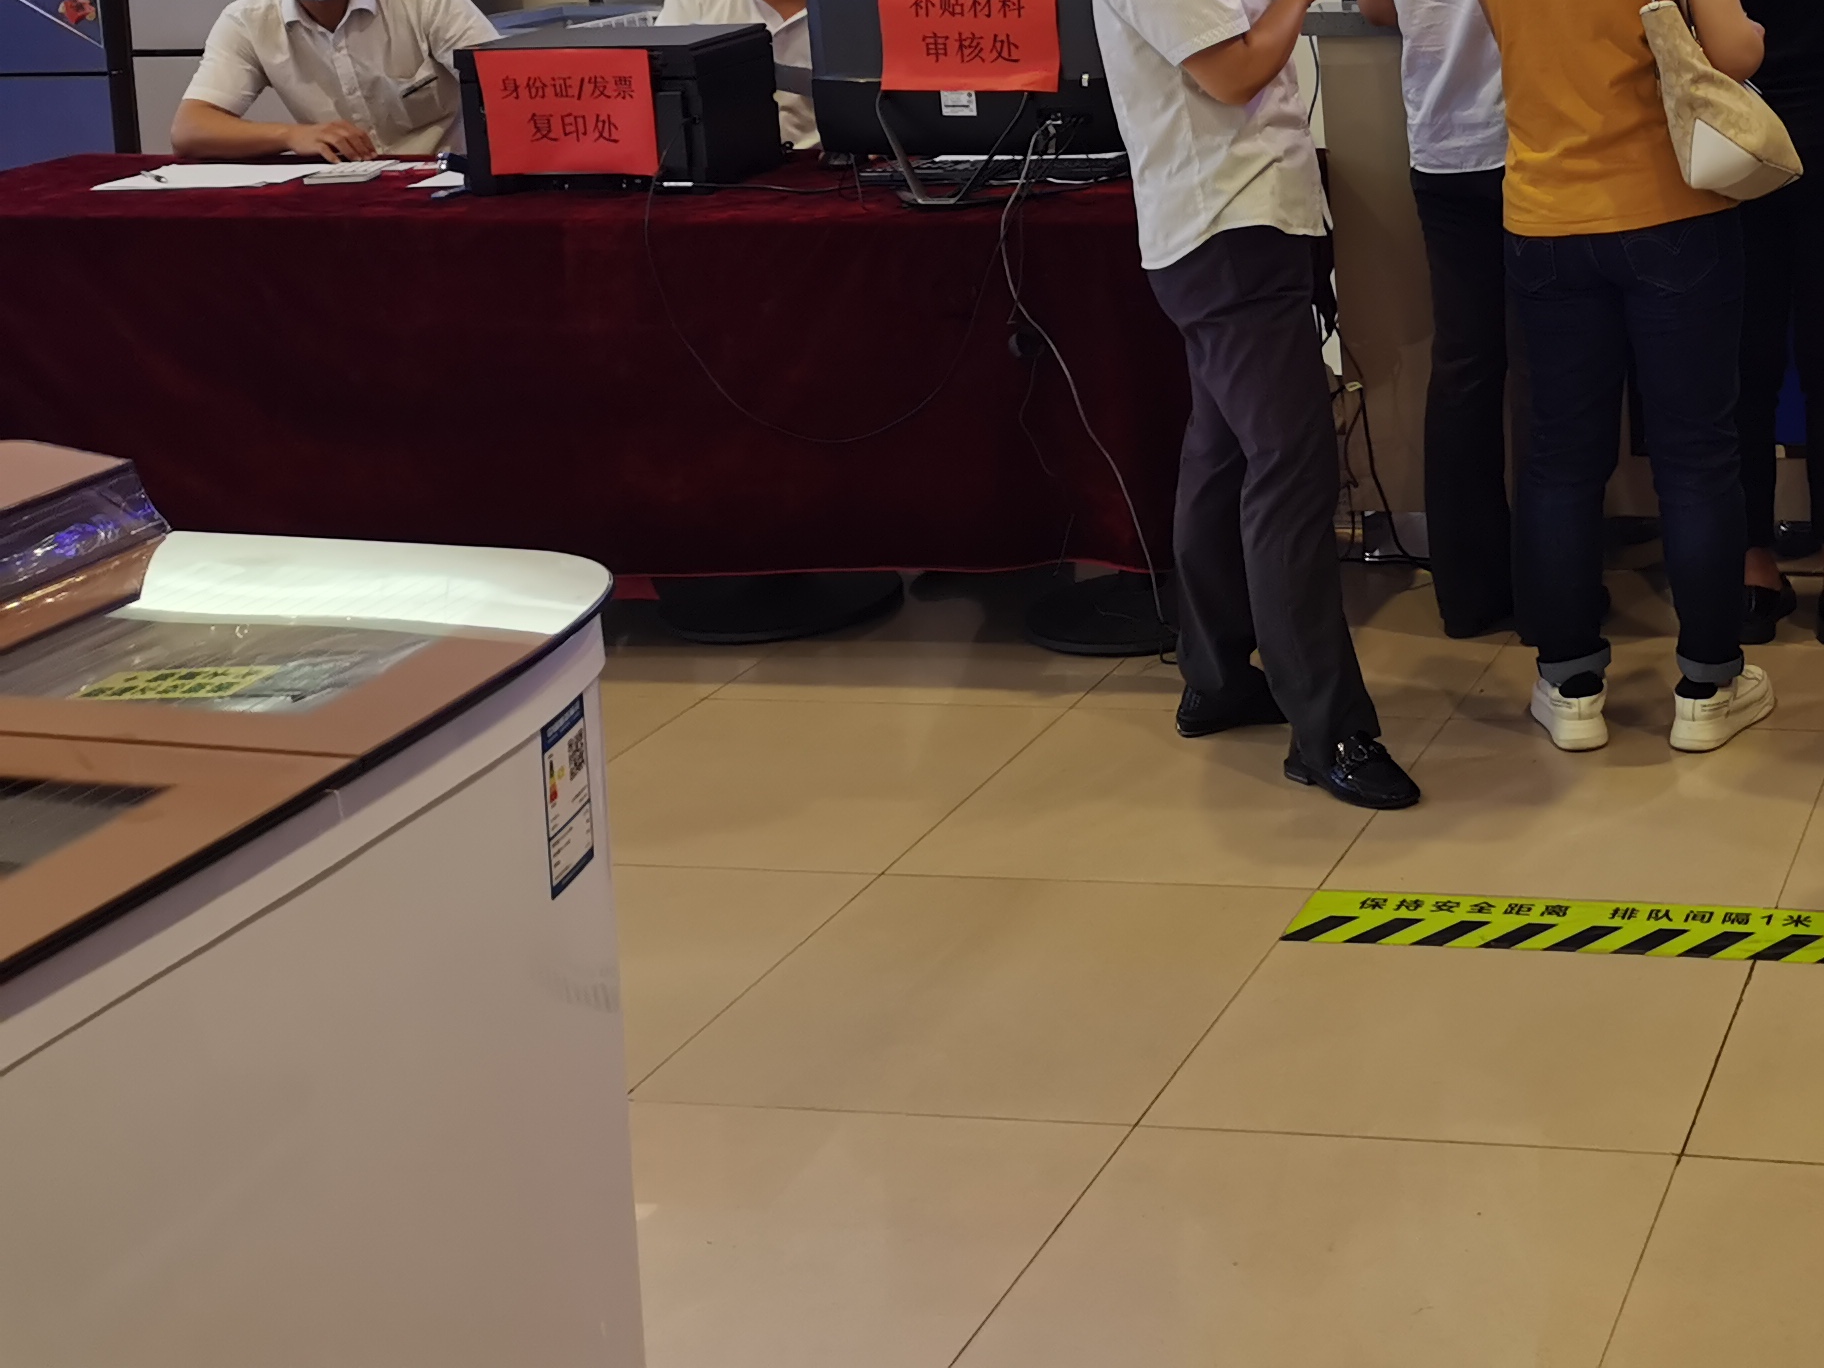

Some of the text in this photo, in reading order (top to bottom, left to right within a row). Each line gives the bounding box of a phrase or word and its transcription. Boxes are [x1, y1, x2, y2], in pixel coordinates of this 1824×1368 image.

[921, 31, 1020, 64] 审核处
[500, 73, 636, 102] 身份证/发票
[526, 111, 621, 143] 复印处
[1358, 895, 1575, 919] 保持安全距离
[1607, 904, 1815, 931] 排队间隔1米
